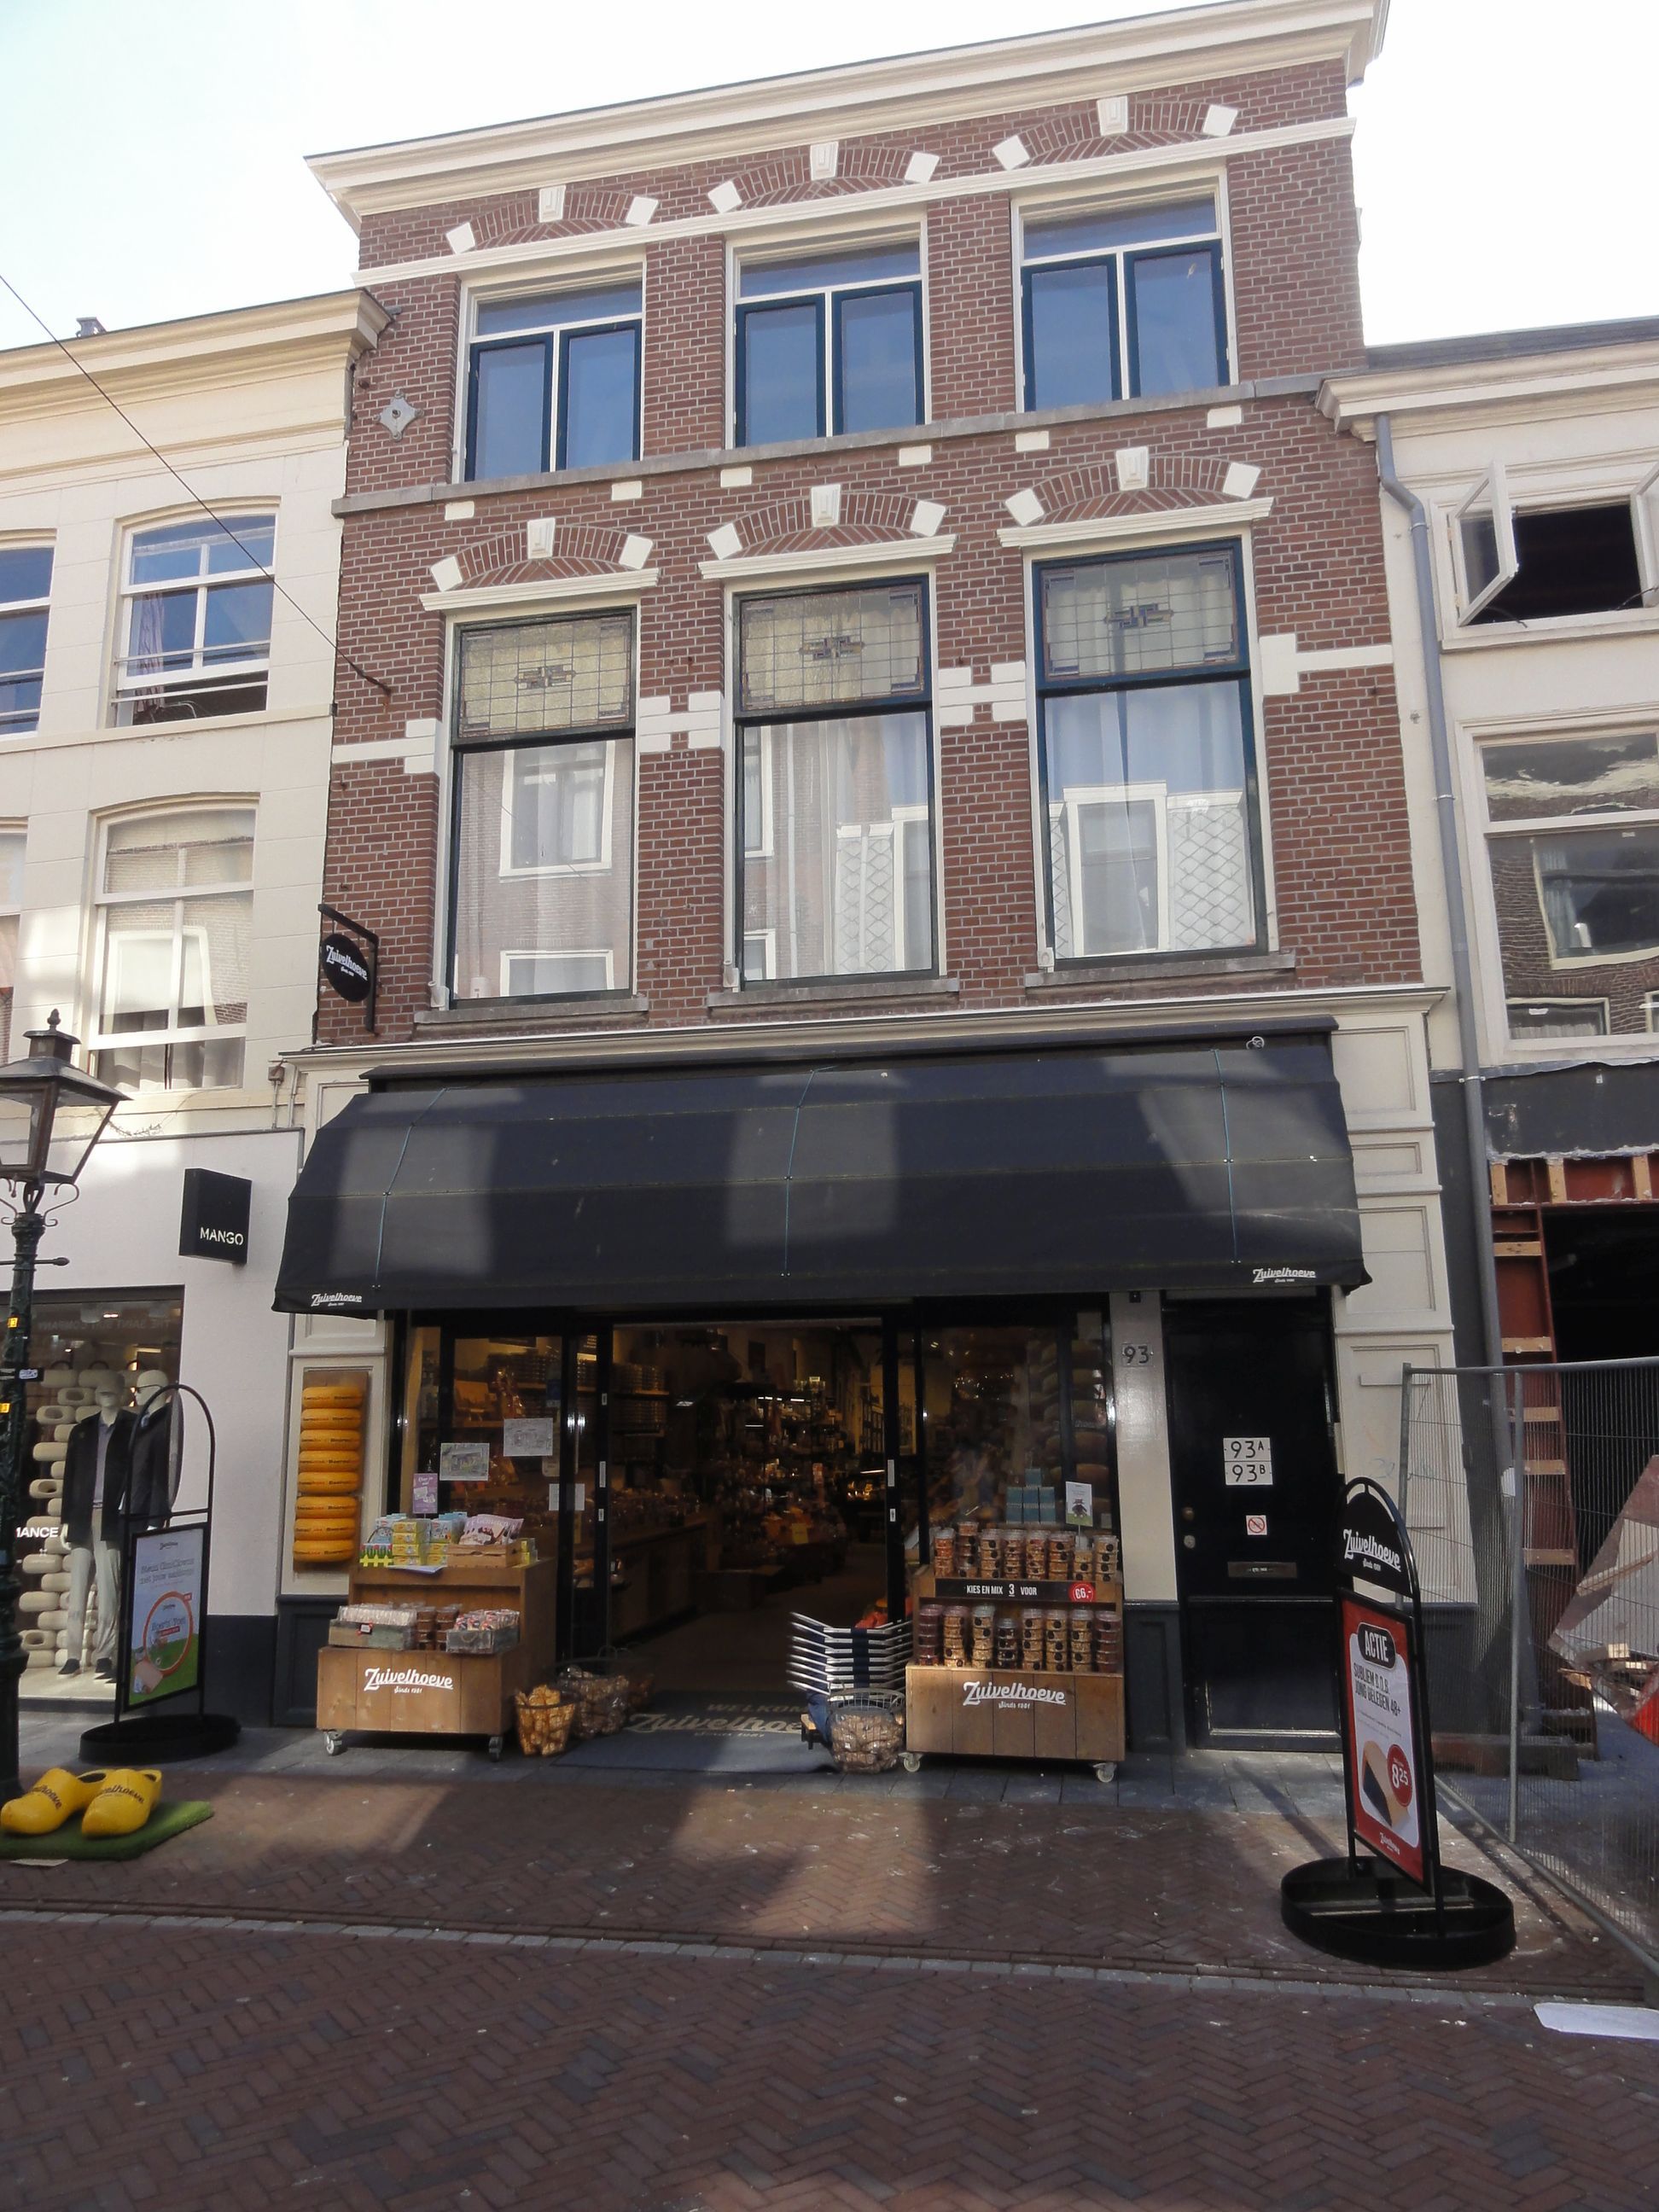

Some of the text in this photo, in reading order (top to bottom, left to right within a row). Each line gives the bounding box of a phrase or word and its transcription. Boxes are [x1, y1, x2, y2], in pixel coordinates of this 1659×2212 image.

[326, 945, 368, 981] Zuivelhoeve
[200, 1226, 244, 1246] MANGO
[1252, 1267, 1316, 1283] Zuivelhoeve
[311, 1292, 362, 1307] Zuivelhoeve
[1123, 1345, 1149, 1364] 93
[1231, 1441, 1264, 1458] 93A
[1232, 1464, 1266, 1482] 93B
[1343, 1528, 1401, 1572] Zuivelhoeve
[966, 1583, 1037, 1596] KIES EN MIX 3 VOOR
[1365, 1630, 1389, 1662] ACTIE
[364, 1668, 453, 1691] Zuivelhoeve
[963, 1680, 1066, 1706] Zuivelhoeve
[622, 1713, 802, 1733] Zuivelhoe
